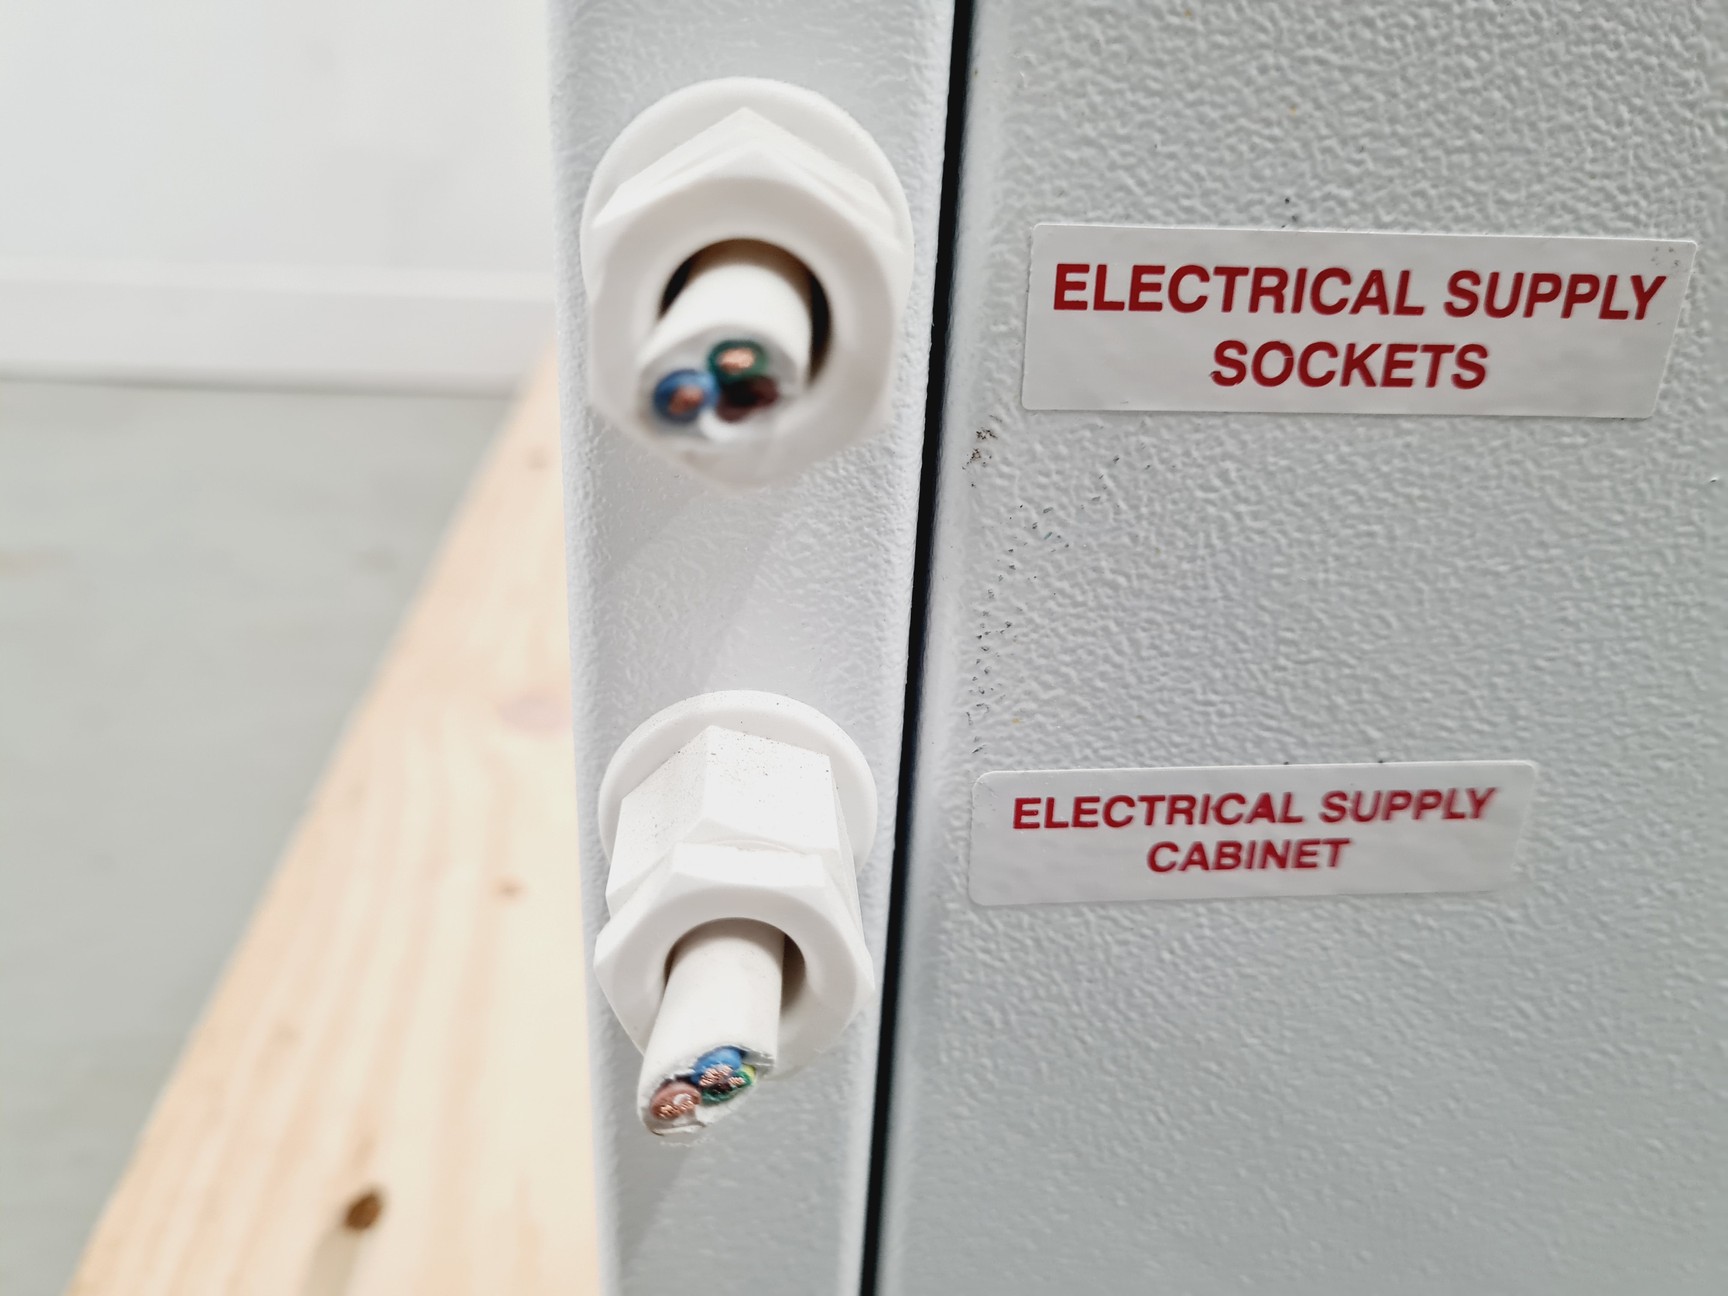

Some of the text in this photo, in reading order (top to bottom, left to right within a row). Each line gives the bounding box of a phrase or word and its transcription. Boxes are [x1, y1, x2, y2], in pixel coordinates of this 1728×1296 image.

[1053, 263, 1667, 321] ELECTRICAL SUPPLY
[1210, 339, 1489, 390] SOCKETS
[1012, 787, 1496, 830] ELECTRICAL SUPPLY
[1147, 838, 1353, 874] CABINET
